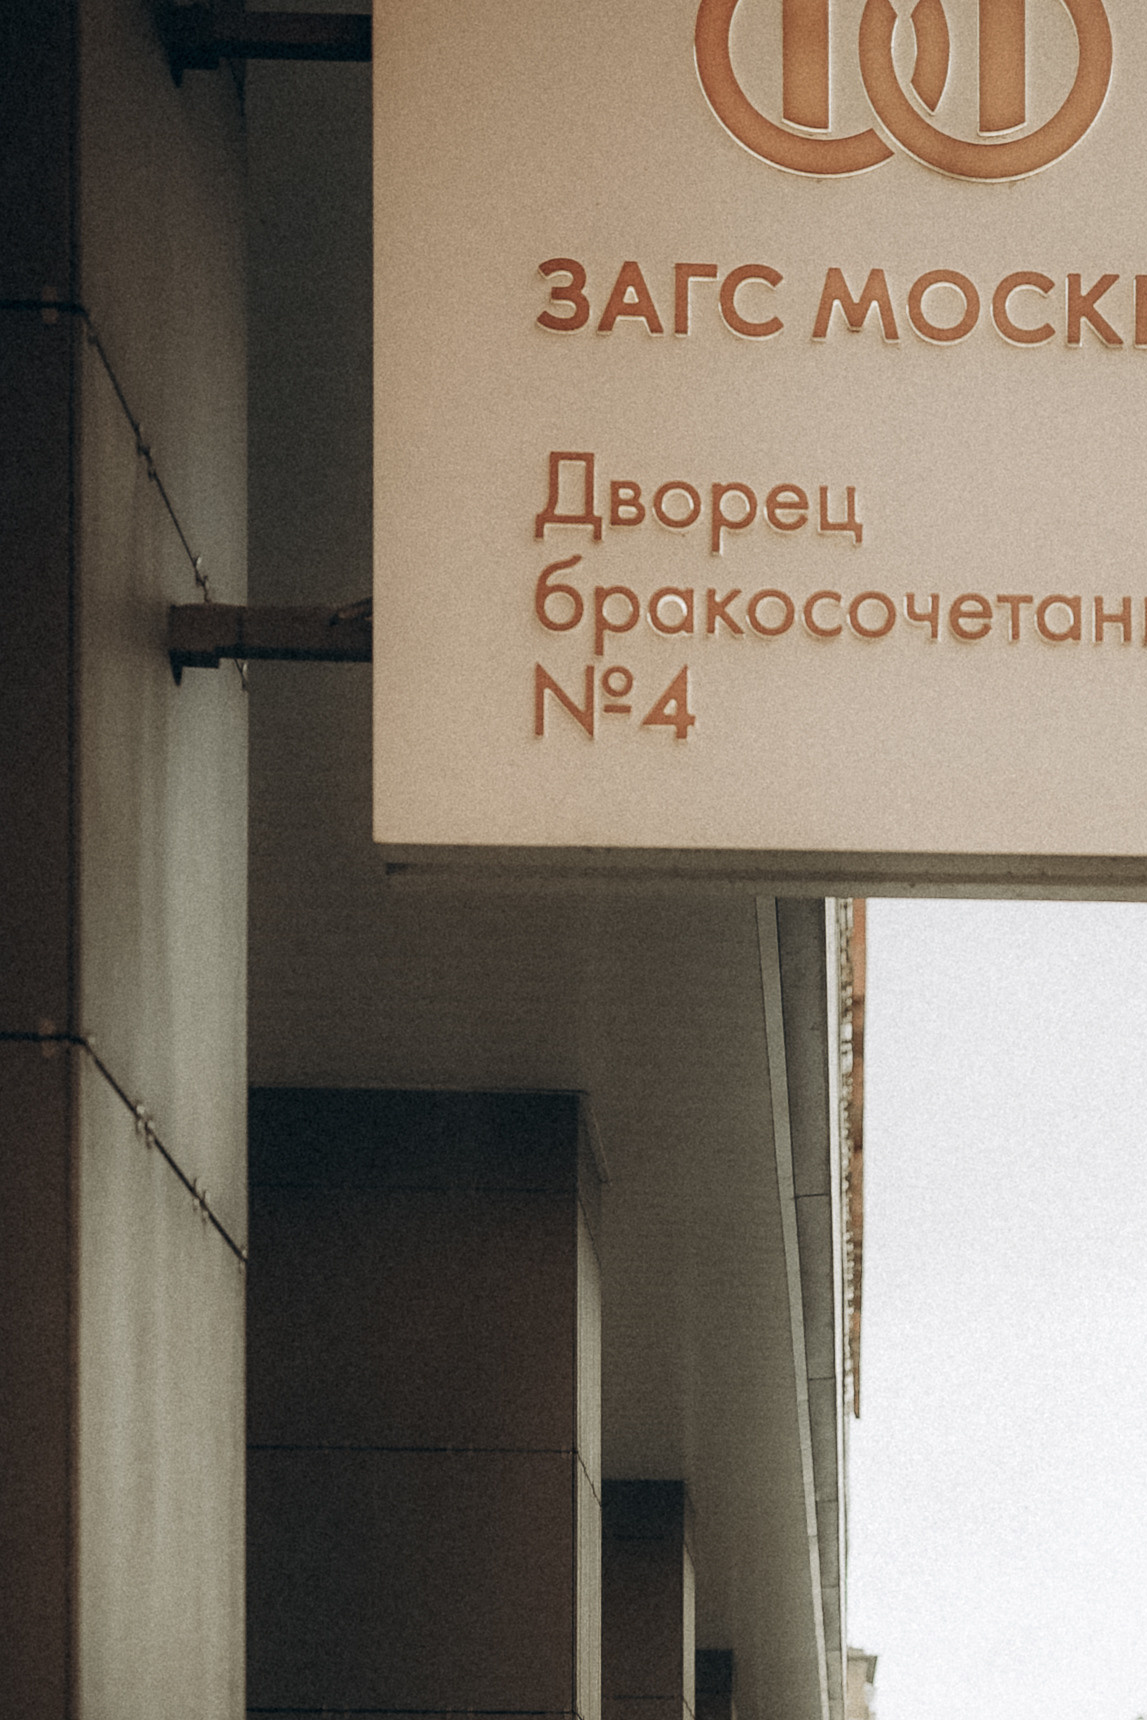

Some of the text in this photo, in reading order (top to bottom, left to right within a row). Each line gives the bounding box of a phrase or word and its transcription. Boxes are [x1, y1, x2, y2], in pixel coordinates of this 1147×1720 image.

[533, 256, 784, 339] ЗАГС
[532, 450, 864, 556] Дворец
[532, 663, 697, 742] №4
